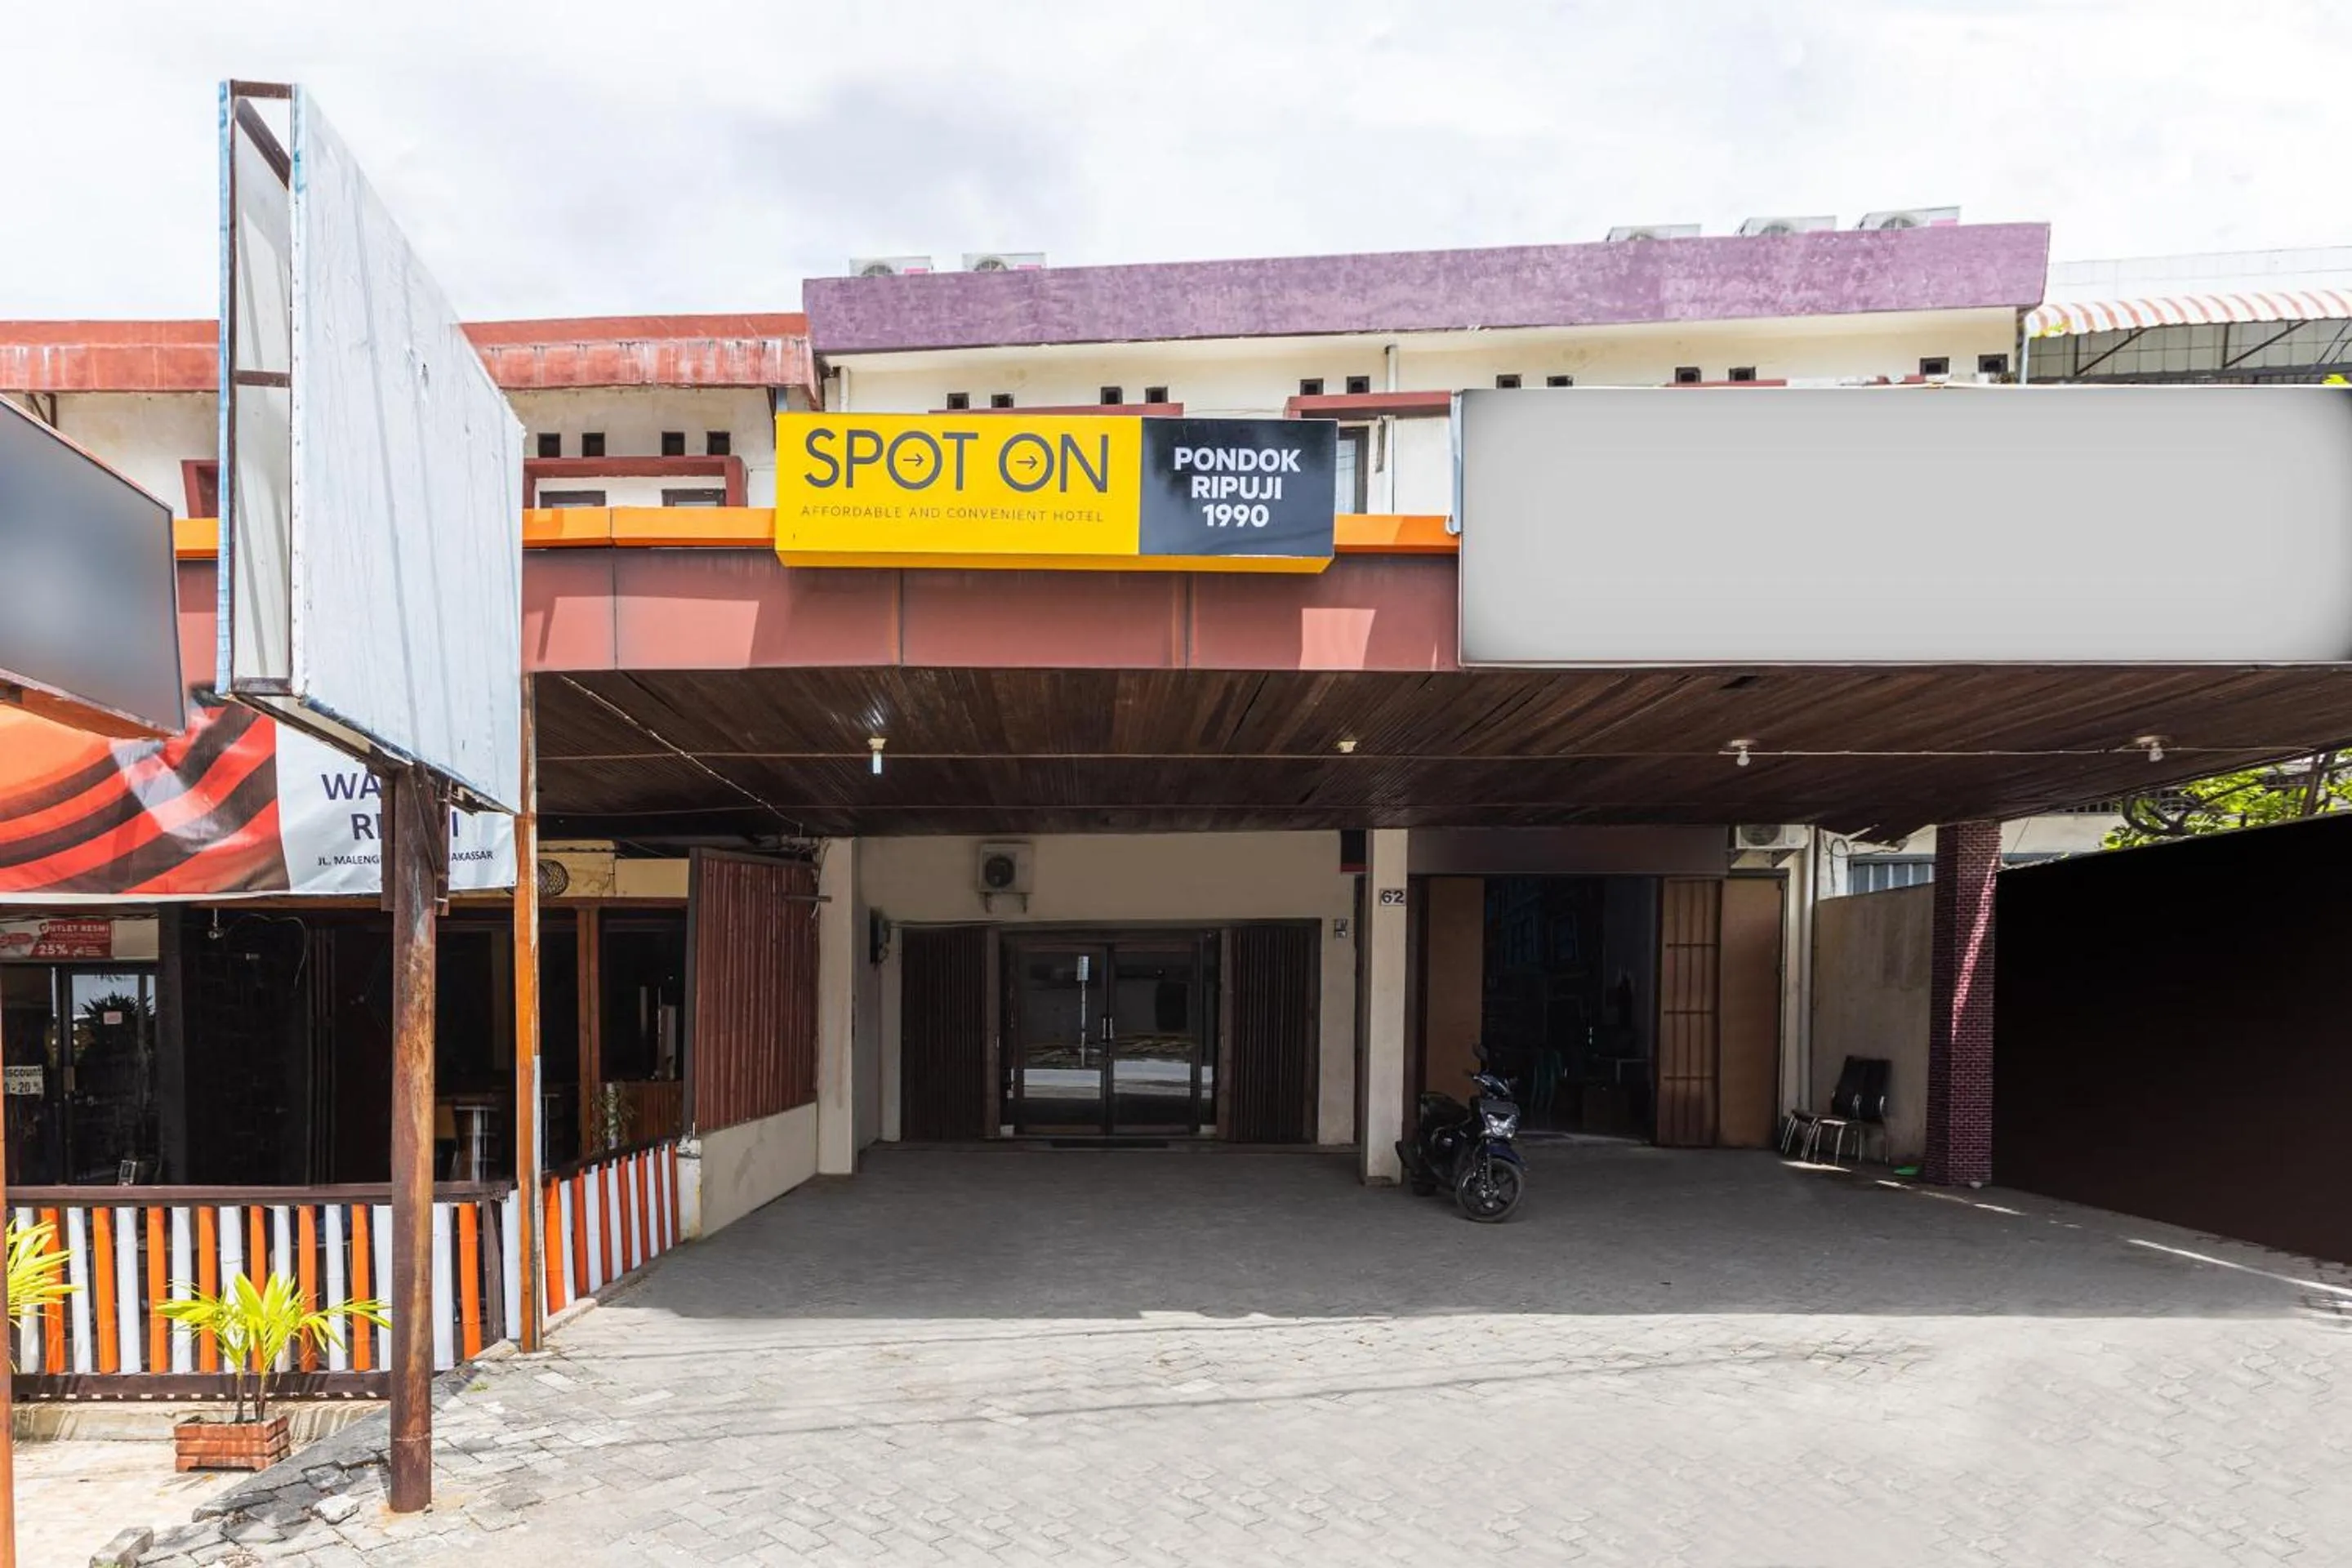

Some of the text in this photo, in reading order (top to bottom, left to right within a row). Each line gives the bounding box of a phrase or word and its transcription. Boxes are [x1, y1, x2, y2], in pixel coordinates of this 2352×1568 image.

[804, 428, 1109, 493] SPOT ON
[1174, 447, 1301, 473] PONDOK
[1191, 475, 1282, 500] RIPUJI
[800, 505, 1103, 523] AFFORDABLE AND CONVENIENT HOTEL
[1202, 503, 1269, 528] 1990
[322, 770, 381, 800] WA
[334, 854, 381, 866] MALENG
[451, 850, 493, 862] AKASSAR
[1381, 890, 1405, 904] 62
